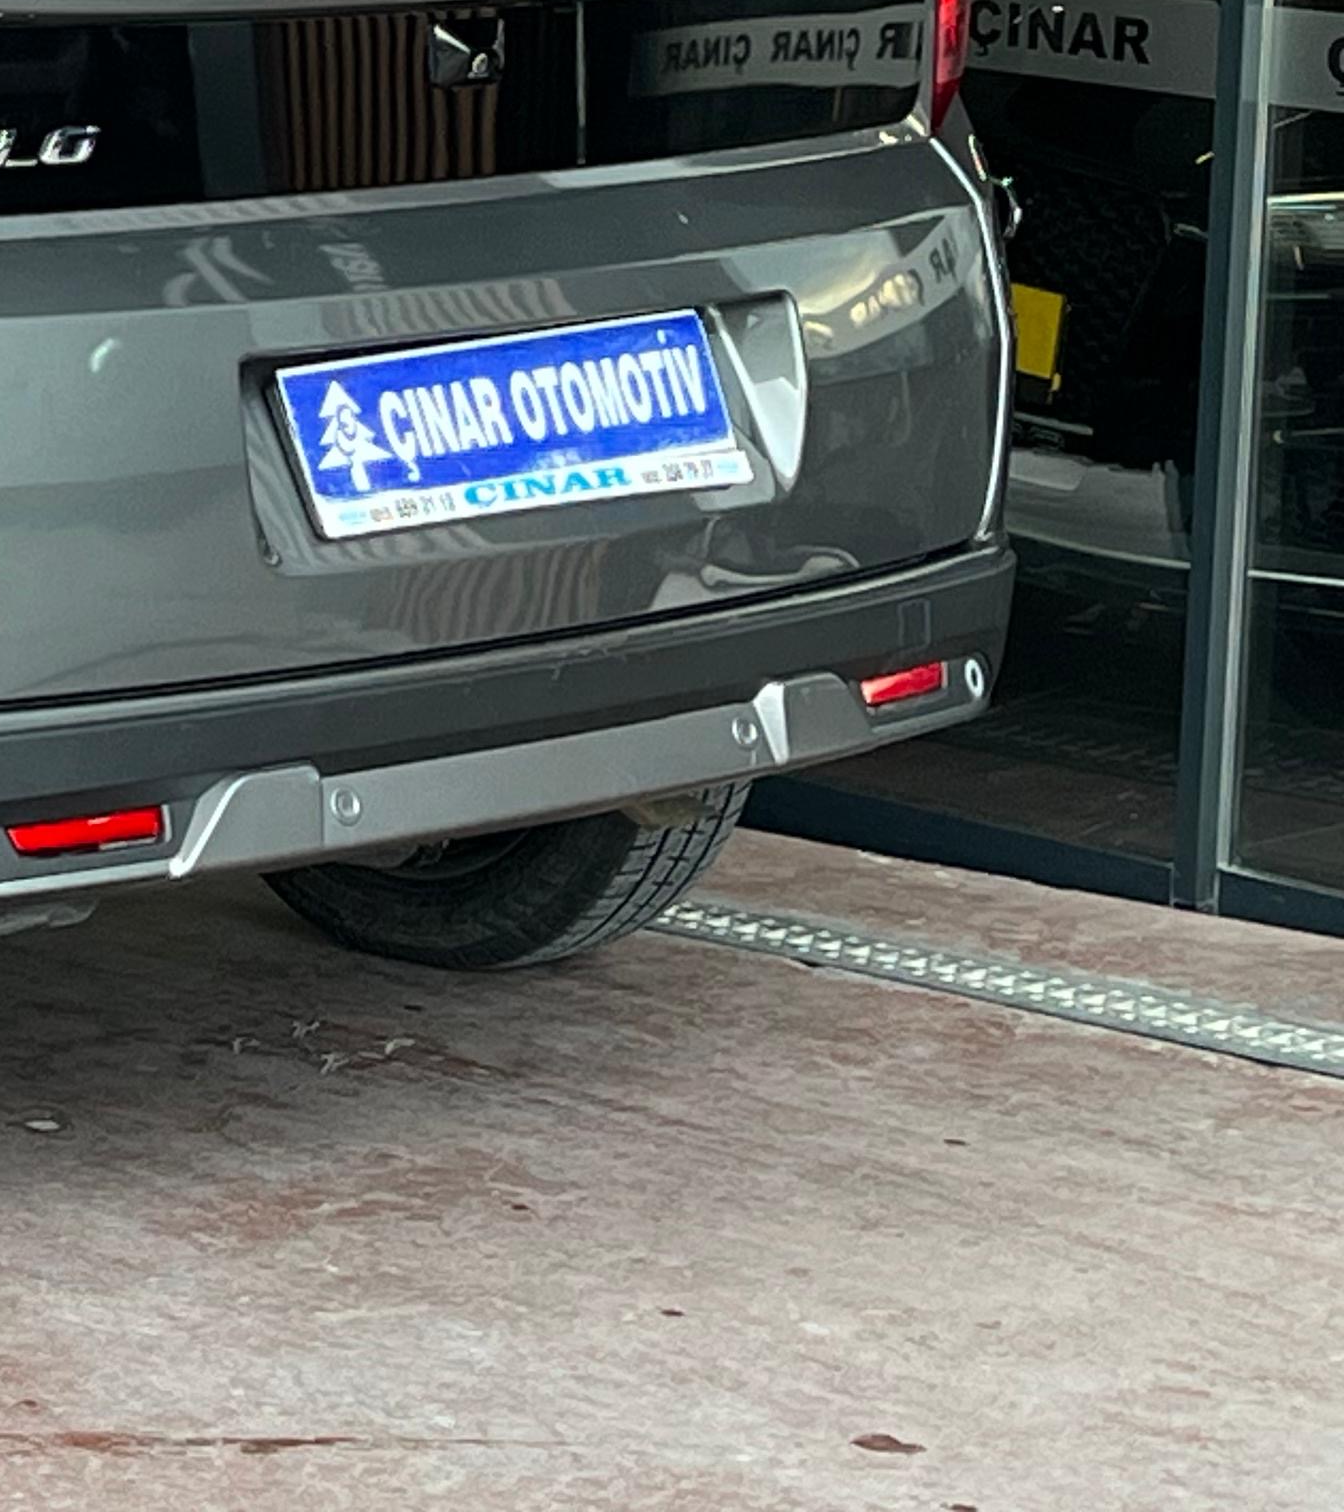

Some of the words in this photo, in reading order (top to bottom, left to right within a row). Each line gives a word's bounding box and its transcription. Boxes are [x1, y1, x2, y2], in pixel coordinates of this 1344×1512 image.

[968, 0, 1150, 65] ÇINAR
[379, 377, 514, 482] ÇINAR
[510, 329, 706, 441] OTOMOTİV
